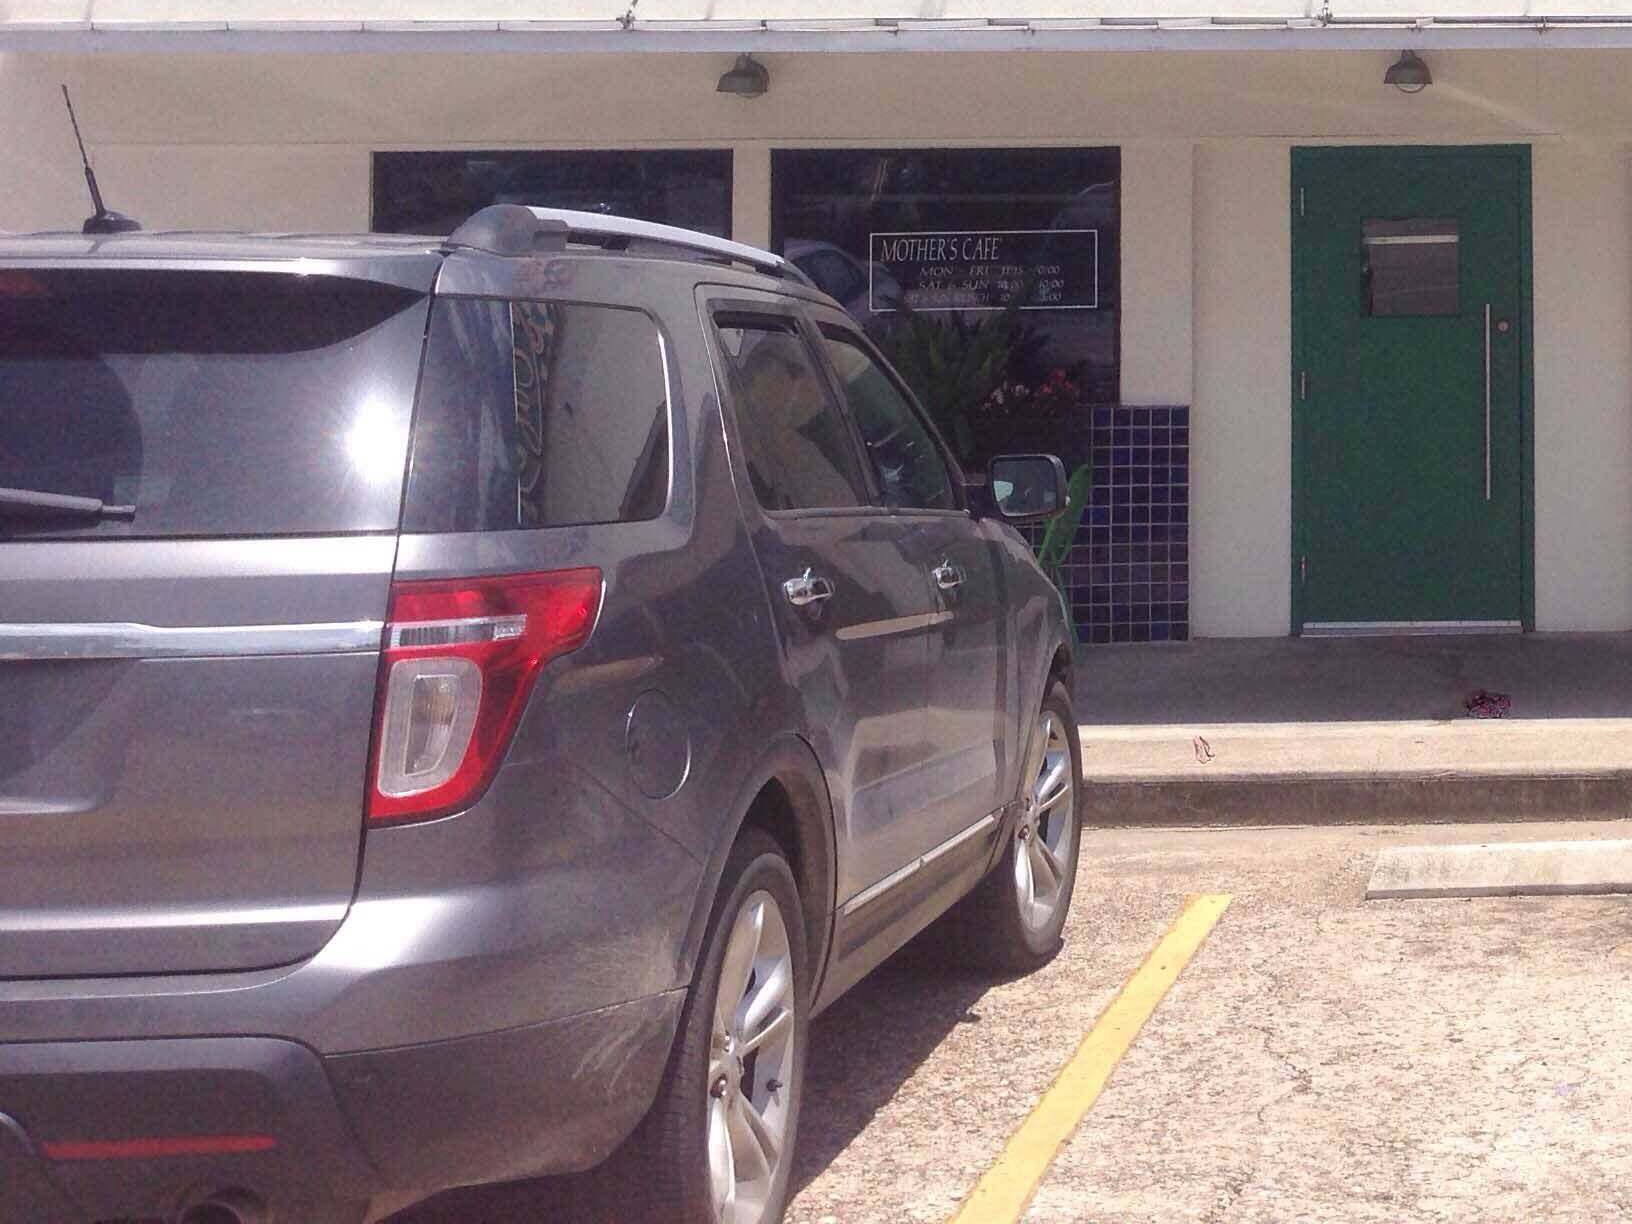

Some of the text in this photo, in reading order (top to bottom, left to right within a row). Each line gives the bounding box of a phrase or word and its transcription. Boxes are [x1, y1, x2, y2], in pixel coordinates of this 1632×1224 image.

[880, 237, 958, 262] MOTHER'S
[920, 265, 953, 276] MON
[969, 264, 990, 275] FRI
[962, 279, 990, 289] SUN
